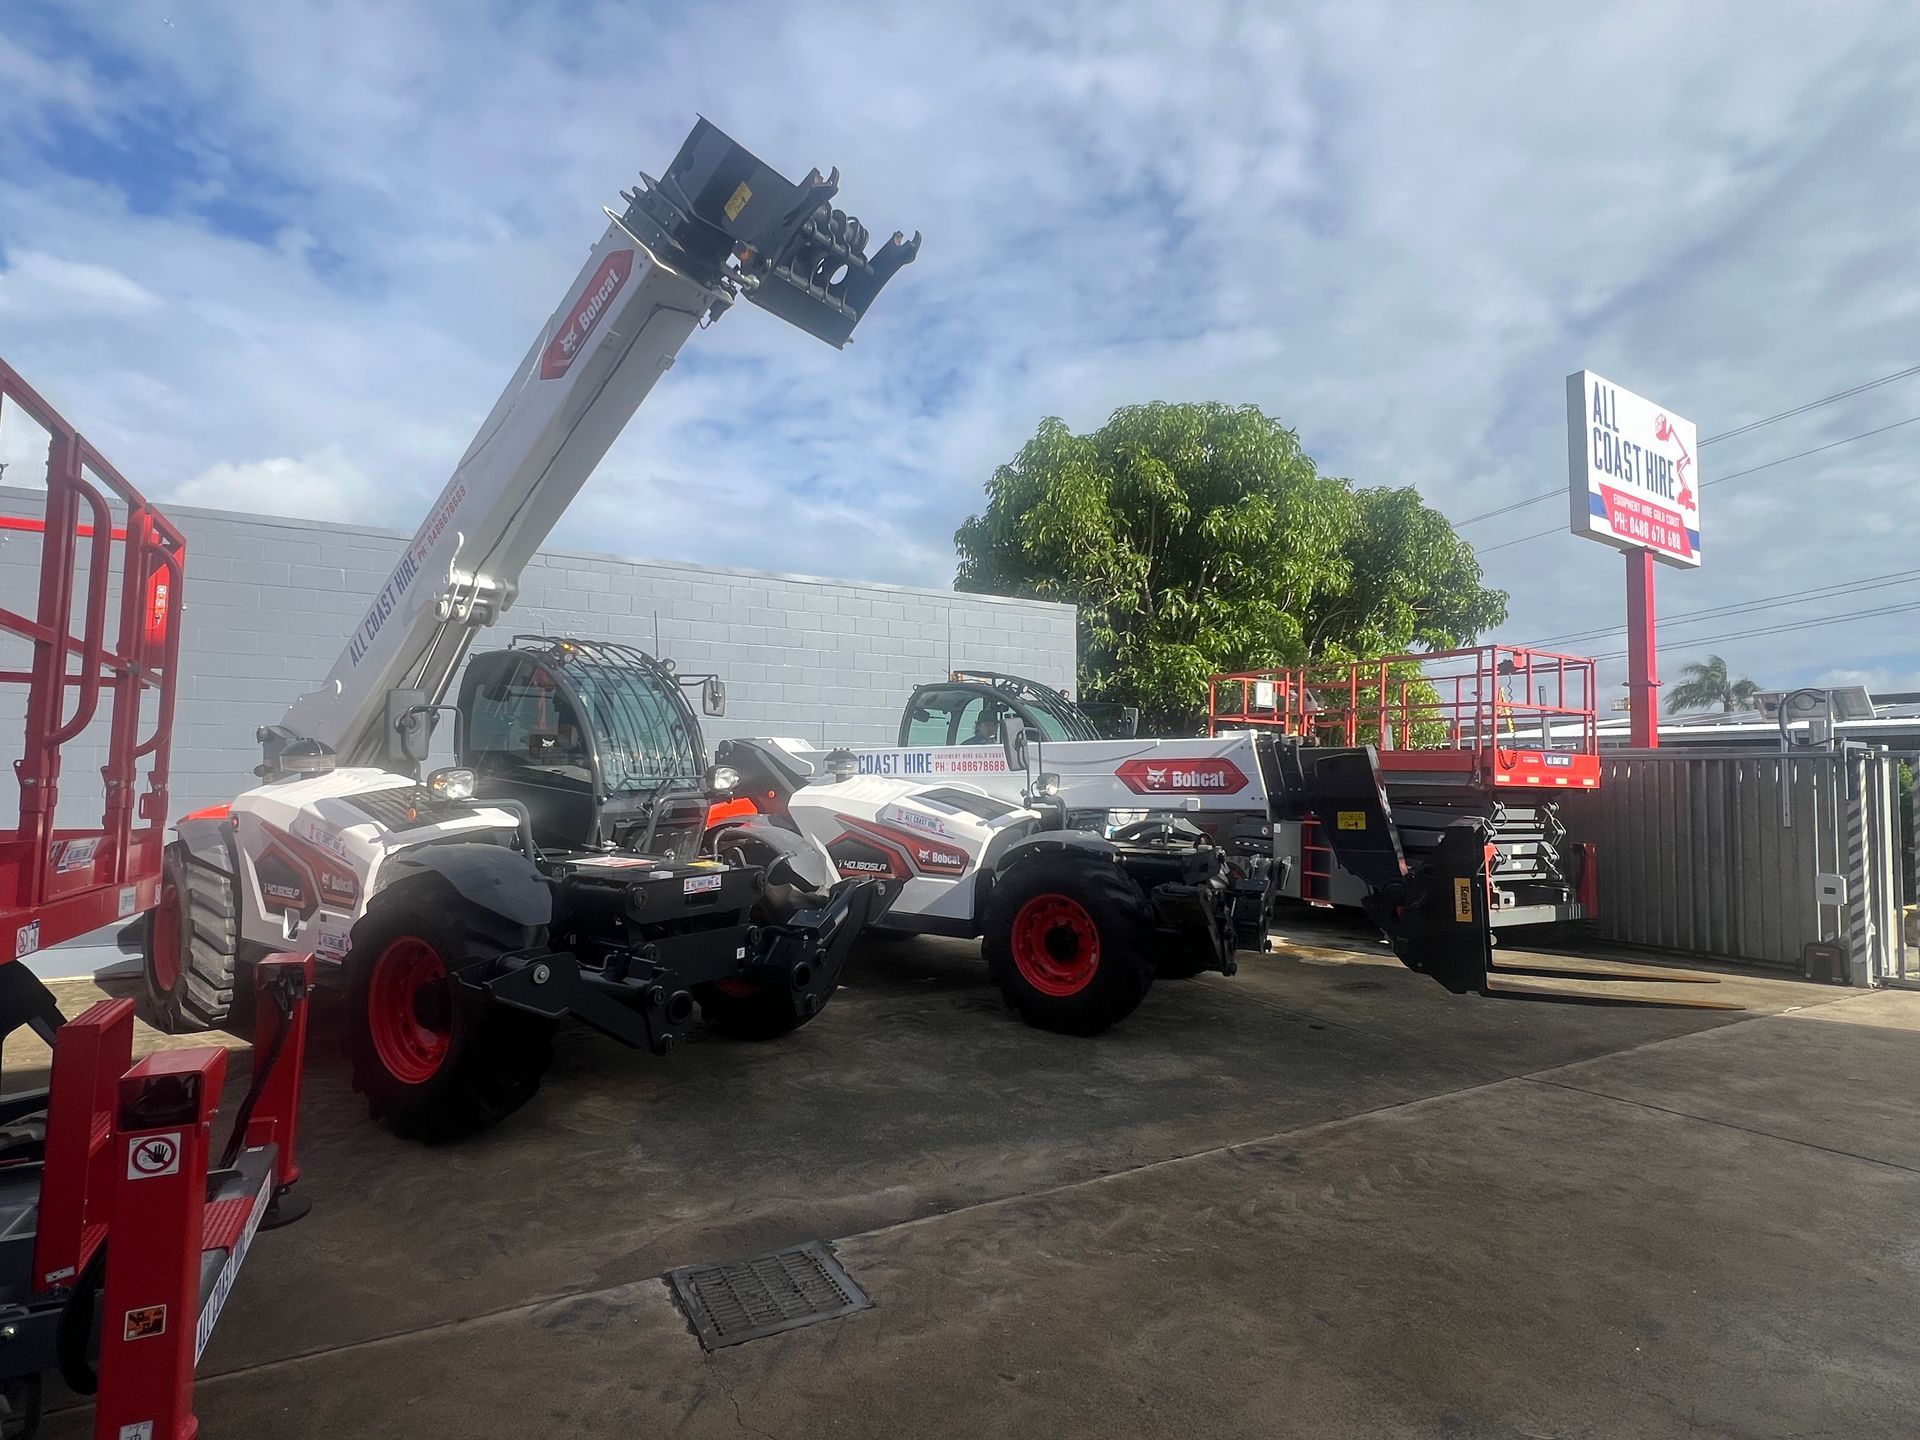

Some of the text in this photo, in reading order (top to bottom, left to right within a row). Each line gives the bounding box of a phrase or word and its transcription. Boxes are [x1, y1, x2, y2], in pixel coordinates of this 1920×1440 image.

[578, 268, 620, 331] Bobcat
[1593, 381, 1619, 433] ALL
[1593, 427, 1675, 501] COAST HIRE
[428, 485, 466, 546] 0488678688
[1613, 493, 1641, 513] EQUIPMENT
[1614, 510, 1681, 550] PH: 0488 678 688
[349, 550, 420, 667] ALL COAST HIRE
[858, 753, 932, 774] COAST HIRE
[951, 760, 1005, 772] 0488678688
[1172, 770, 1225, 787] Bobcat
[932, 851, 960, 865] Bobcat
